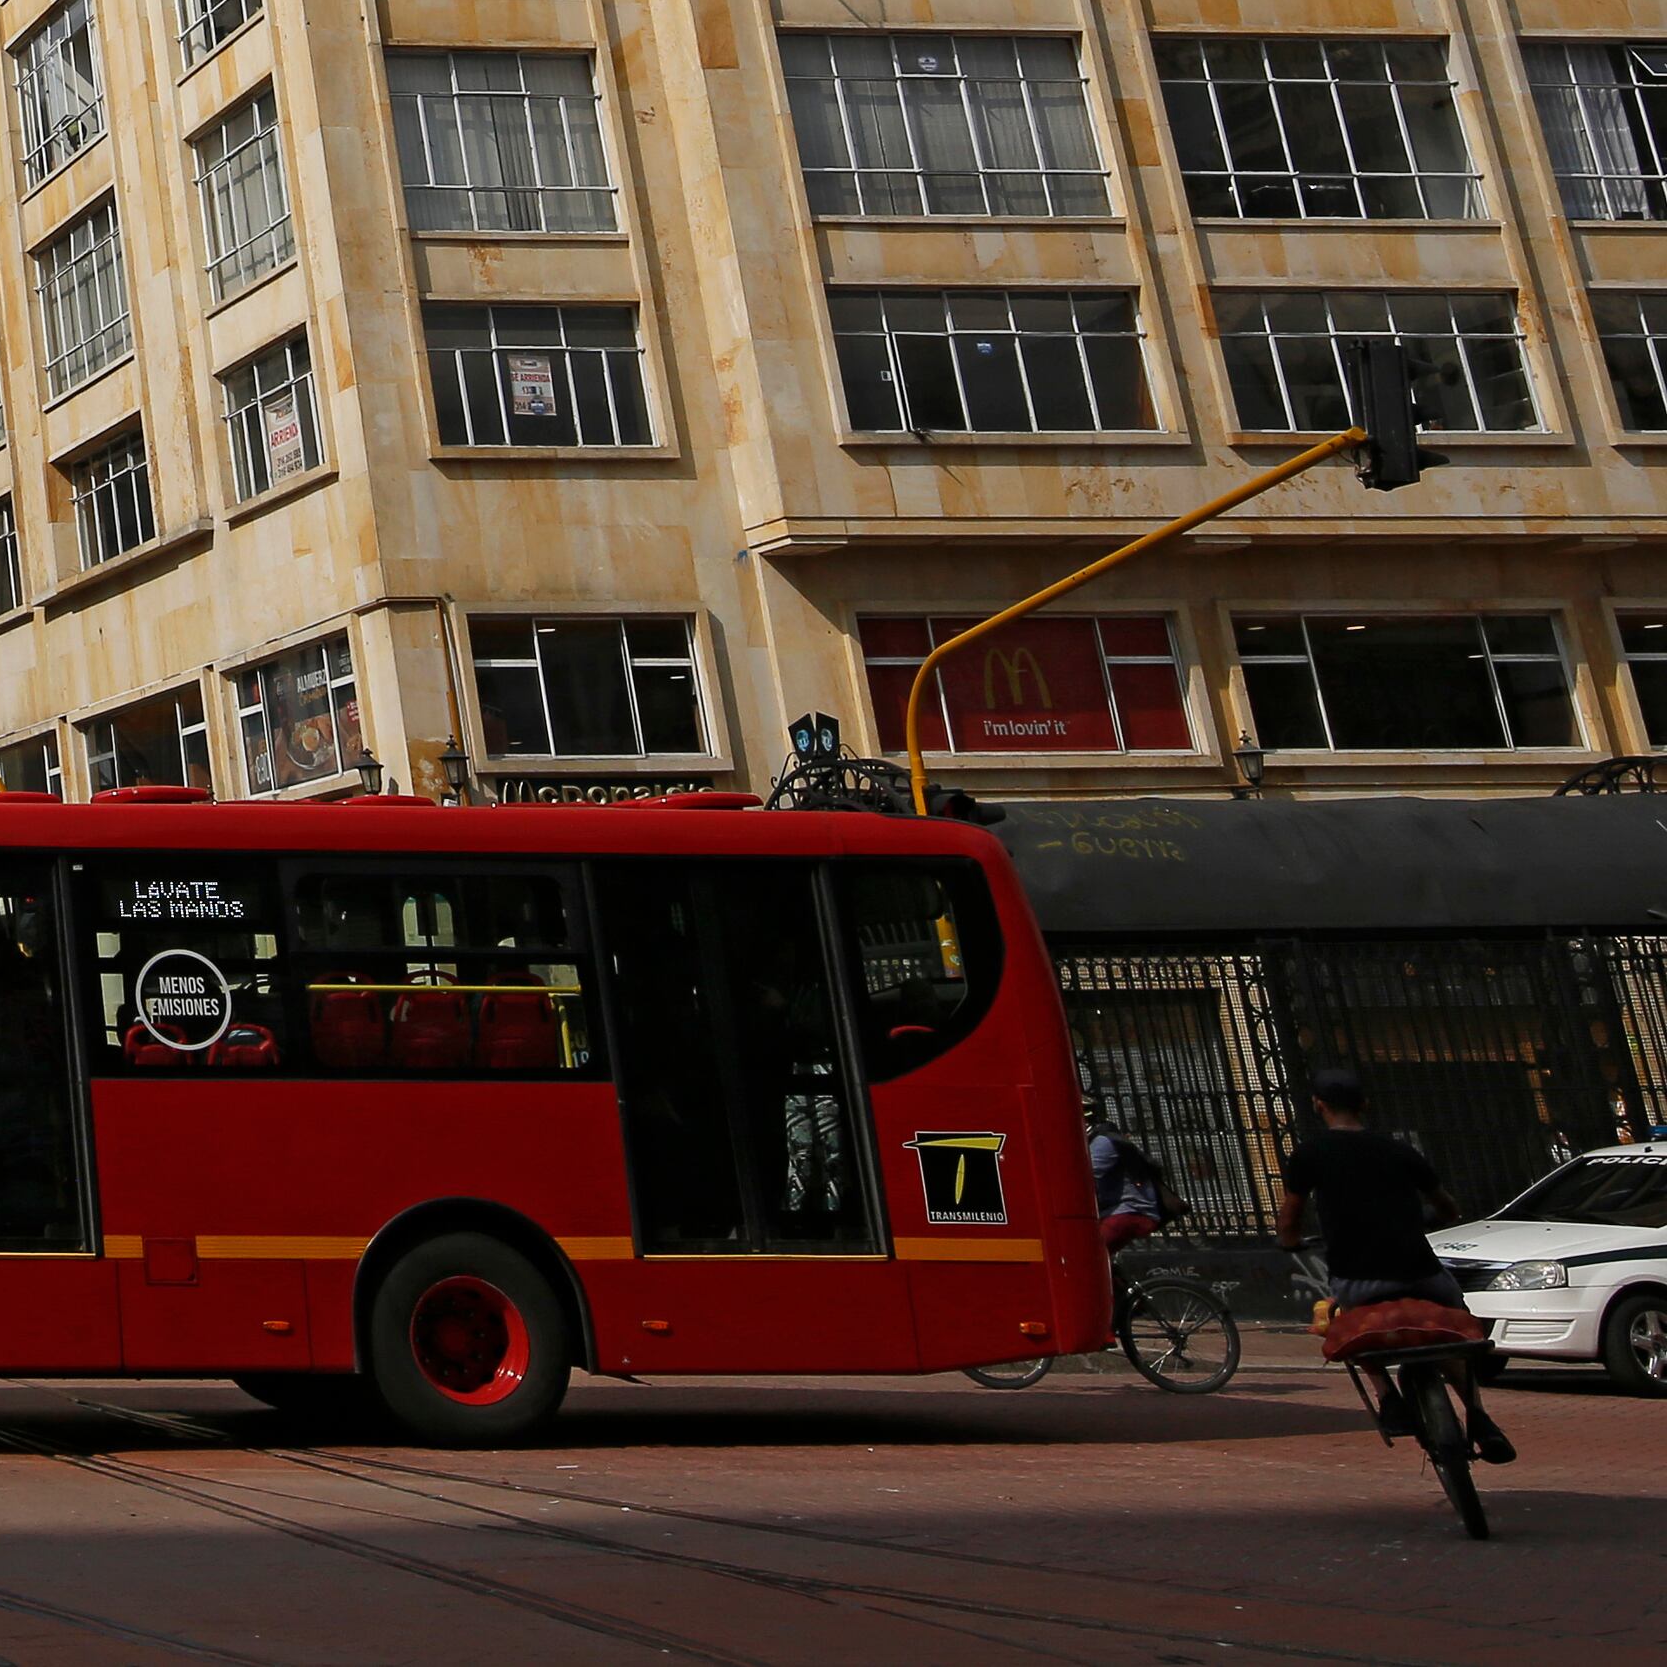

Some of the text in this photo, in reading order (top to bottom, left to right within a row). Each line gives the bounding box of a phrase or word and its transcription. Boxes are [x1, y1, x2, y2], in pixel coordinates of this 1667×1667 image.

[297, 668, 329, 693] ALMUERZ
[1009, 720, 1051, 736] lovin'
[1053, 720, 1067, 736] it
[119, 900, 244, 918] LAS MANOS
[158, 976, 206, 995] MENOS
[151, 998, 220, 1016] EMISIONES
[930, 1211, 1005, 1222] TRANSMILENIO
